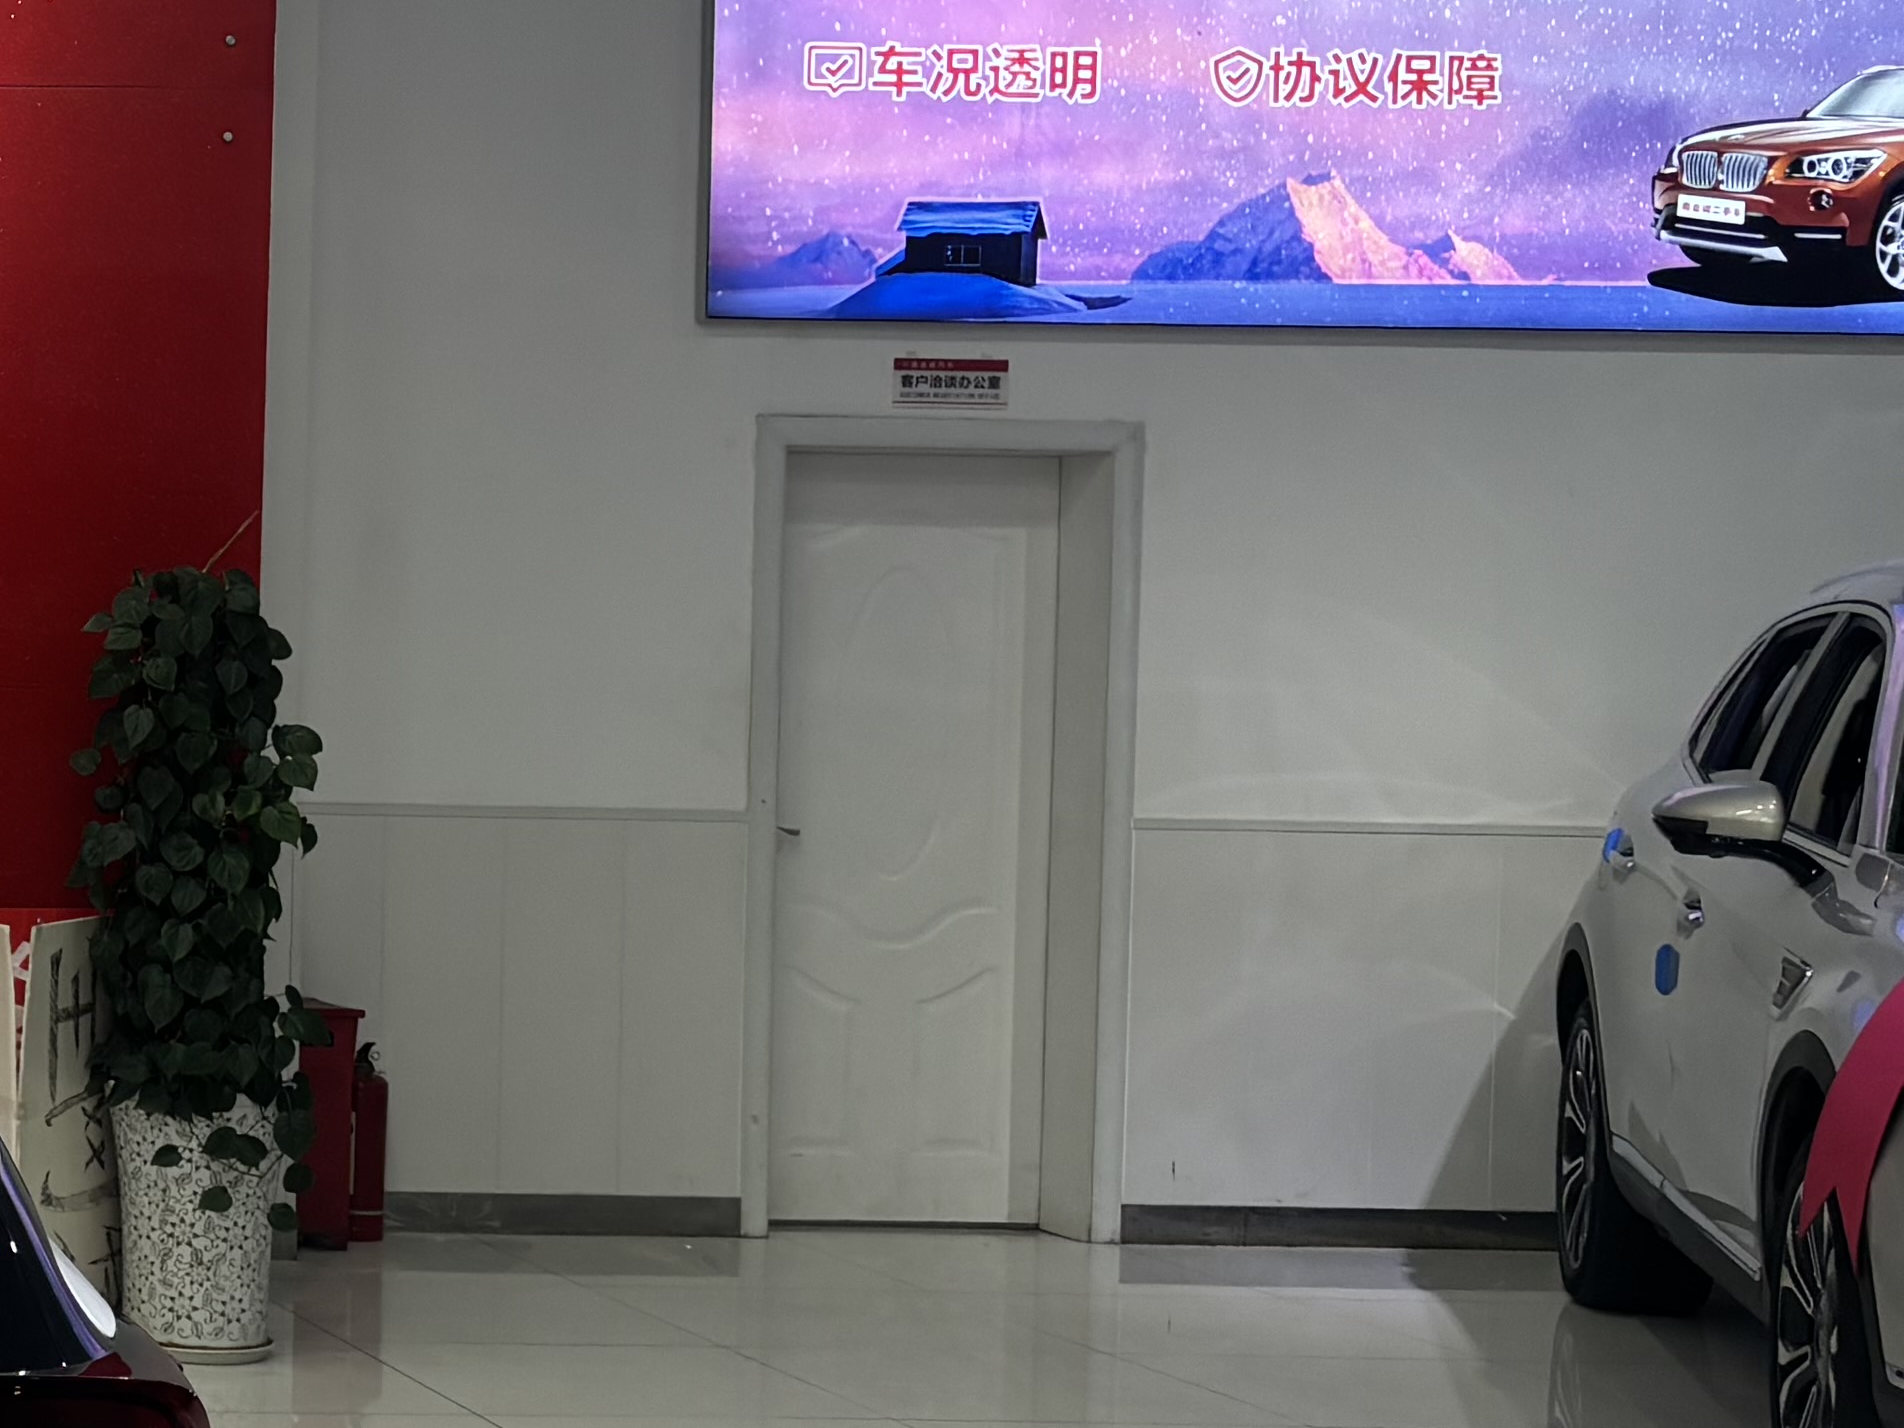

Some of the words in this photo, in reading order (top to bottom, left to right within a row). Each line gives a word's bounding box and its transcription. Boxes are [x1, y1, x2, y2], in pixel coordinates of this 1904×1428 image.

[870, 44, 1103, 105] 车况透明
[1269, 48, 1504, 110] 协议保障
